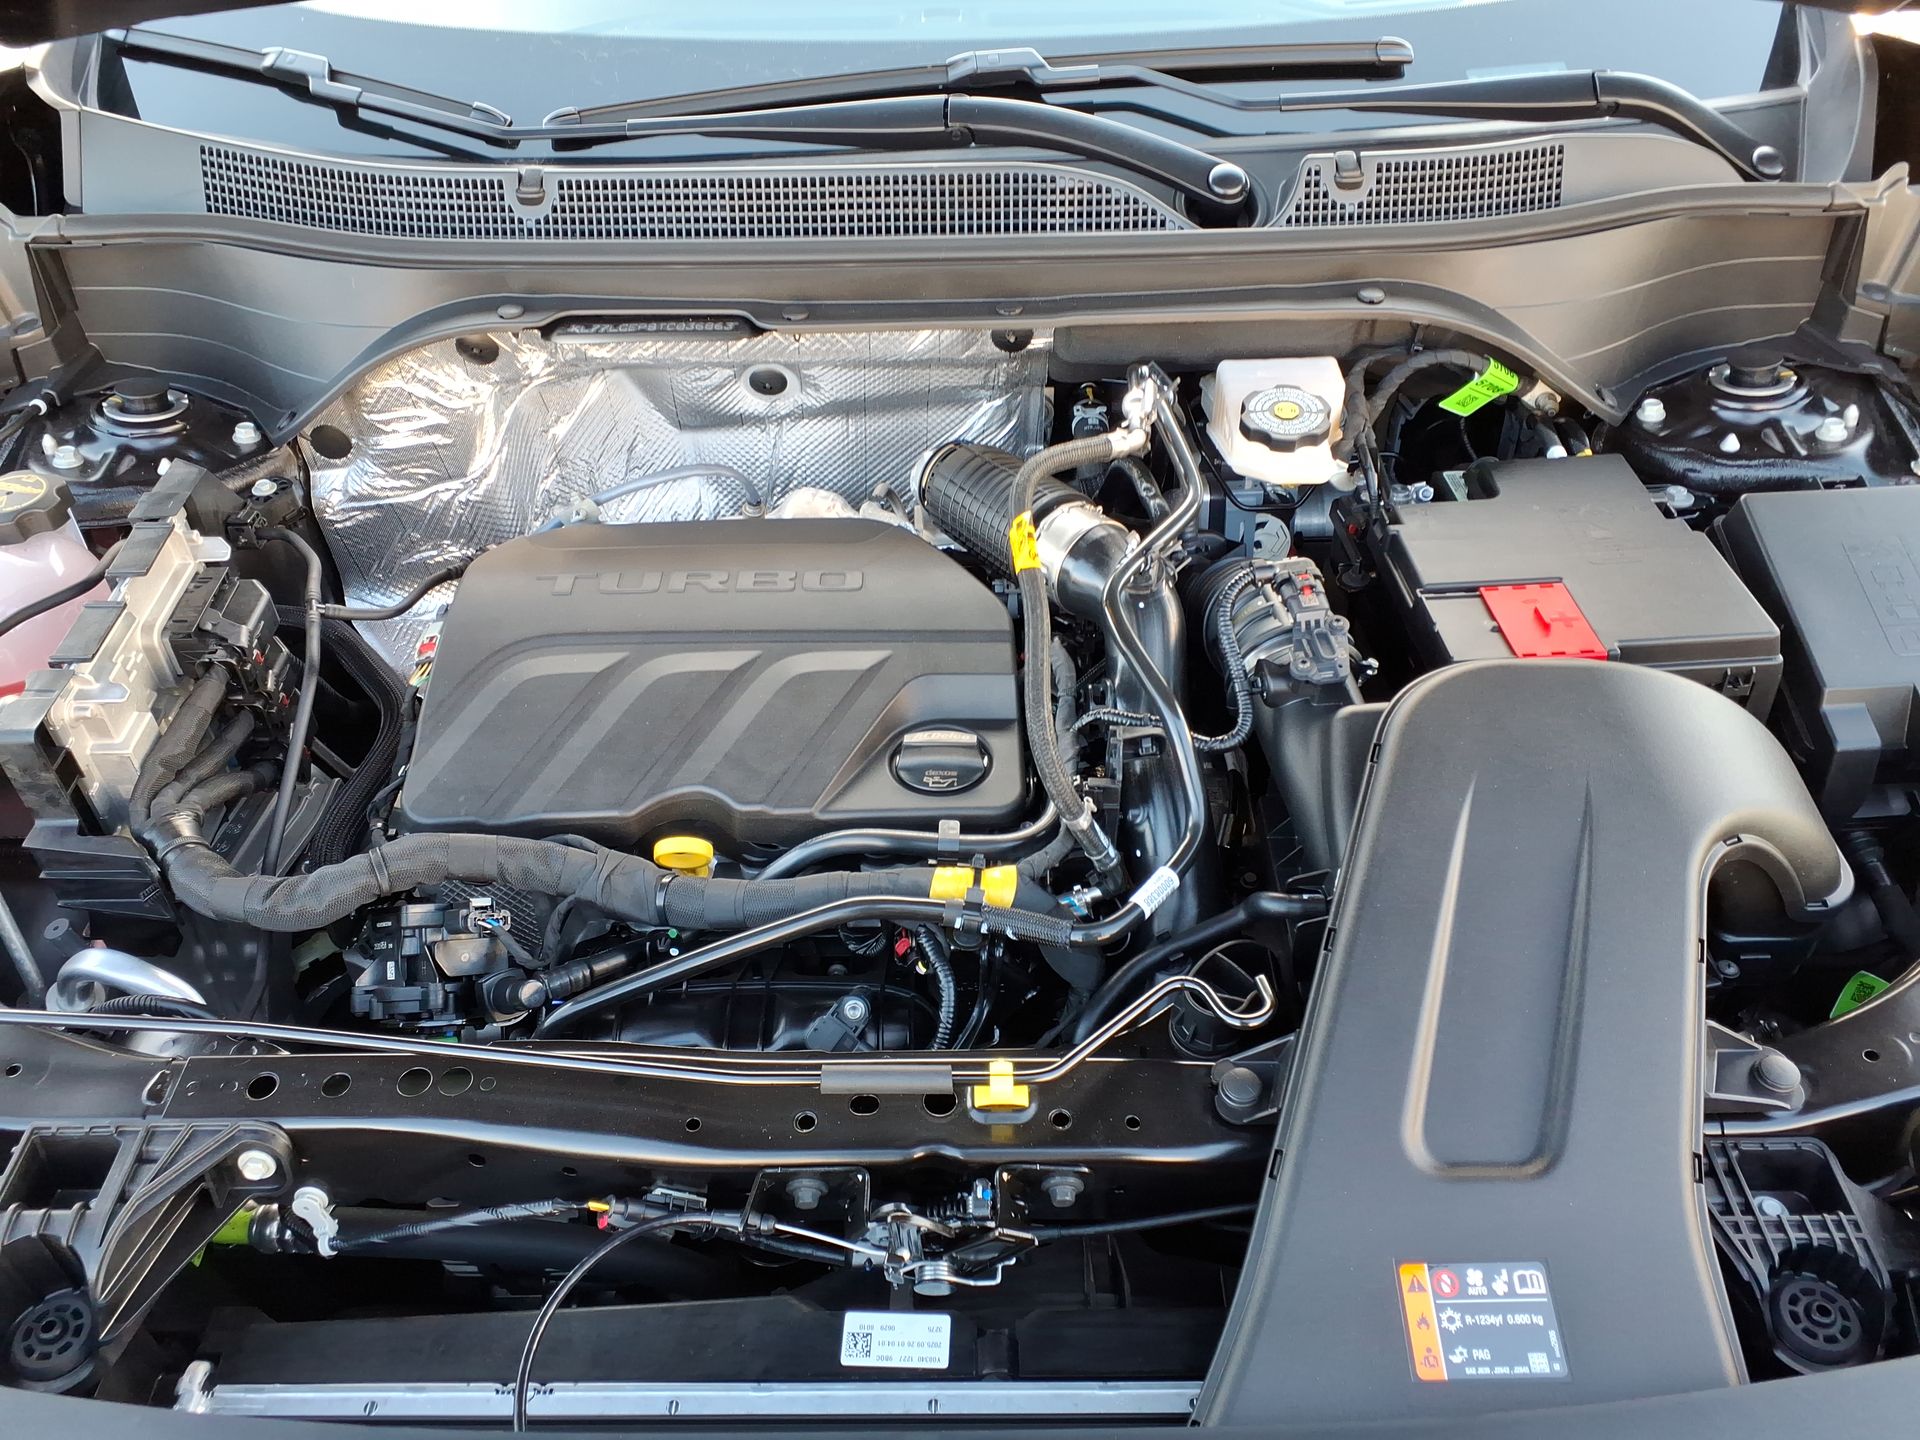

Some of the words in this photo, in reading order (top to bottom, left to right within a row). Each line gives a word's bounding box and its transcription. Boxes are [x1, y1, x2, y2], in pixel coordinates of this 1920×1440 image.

[535, 570, 864, 596] TURBO
[1468, 1286, 1488, 1295] AUTO
[1531, 1314, 1544, 1327] kg
[1472, 1349, 1491, 1360] PAG
